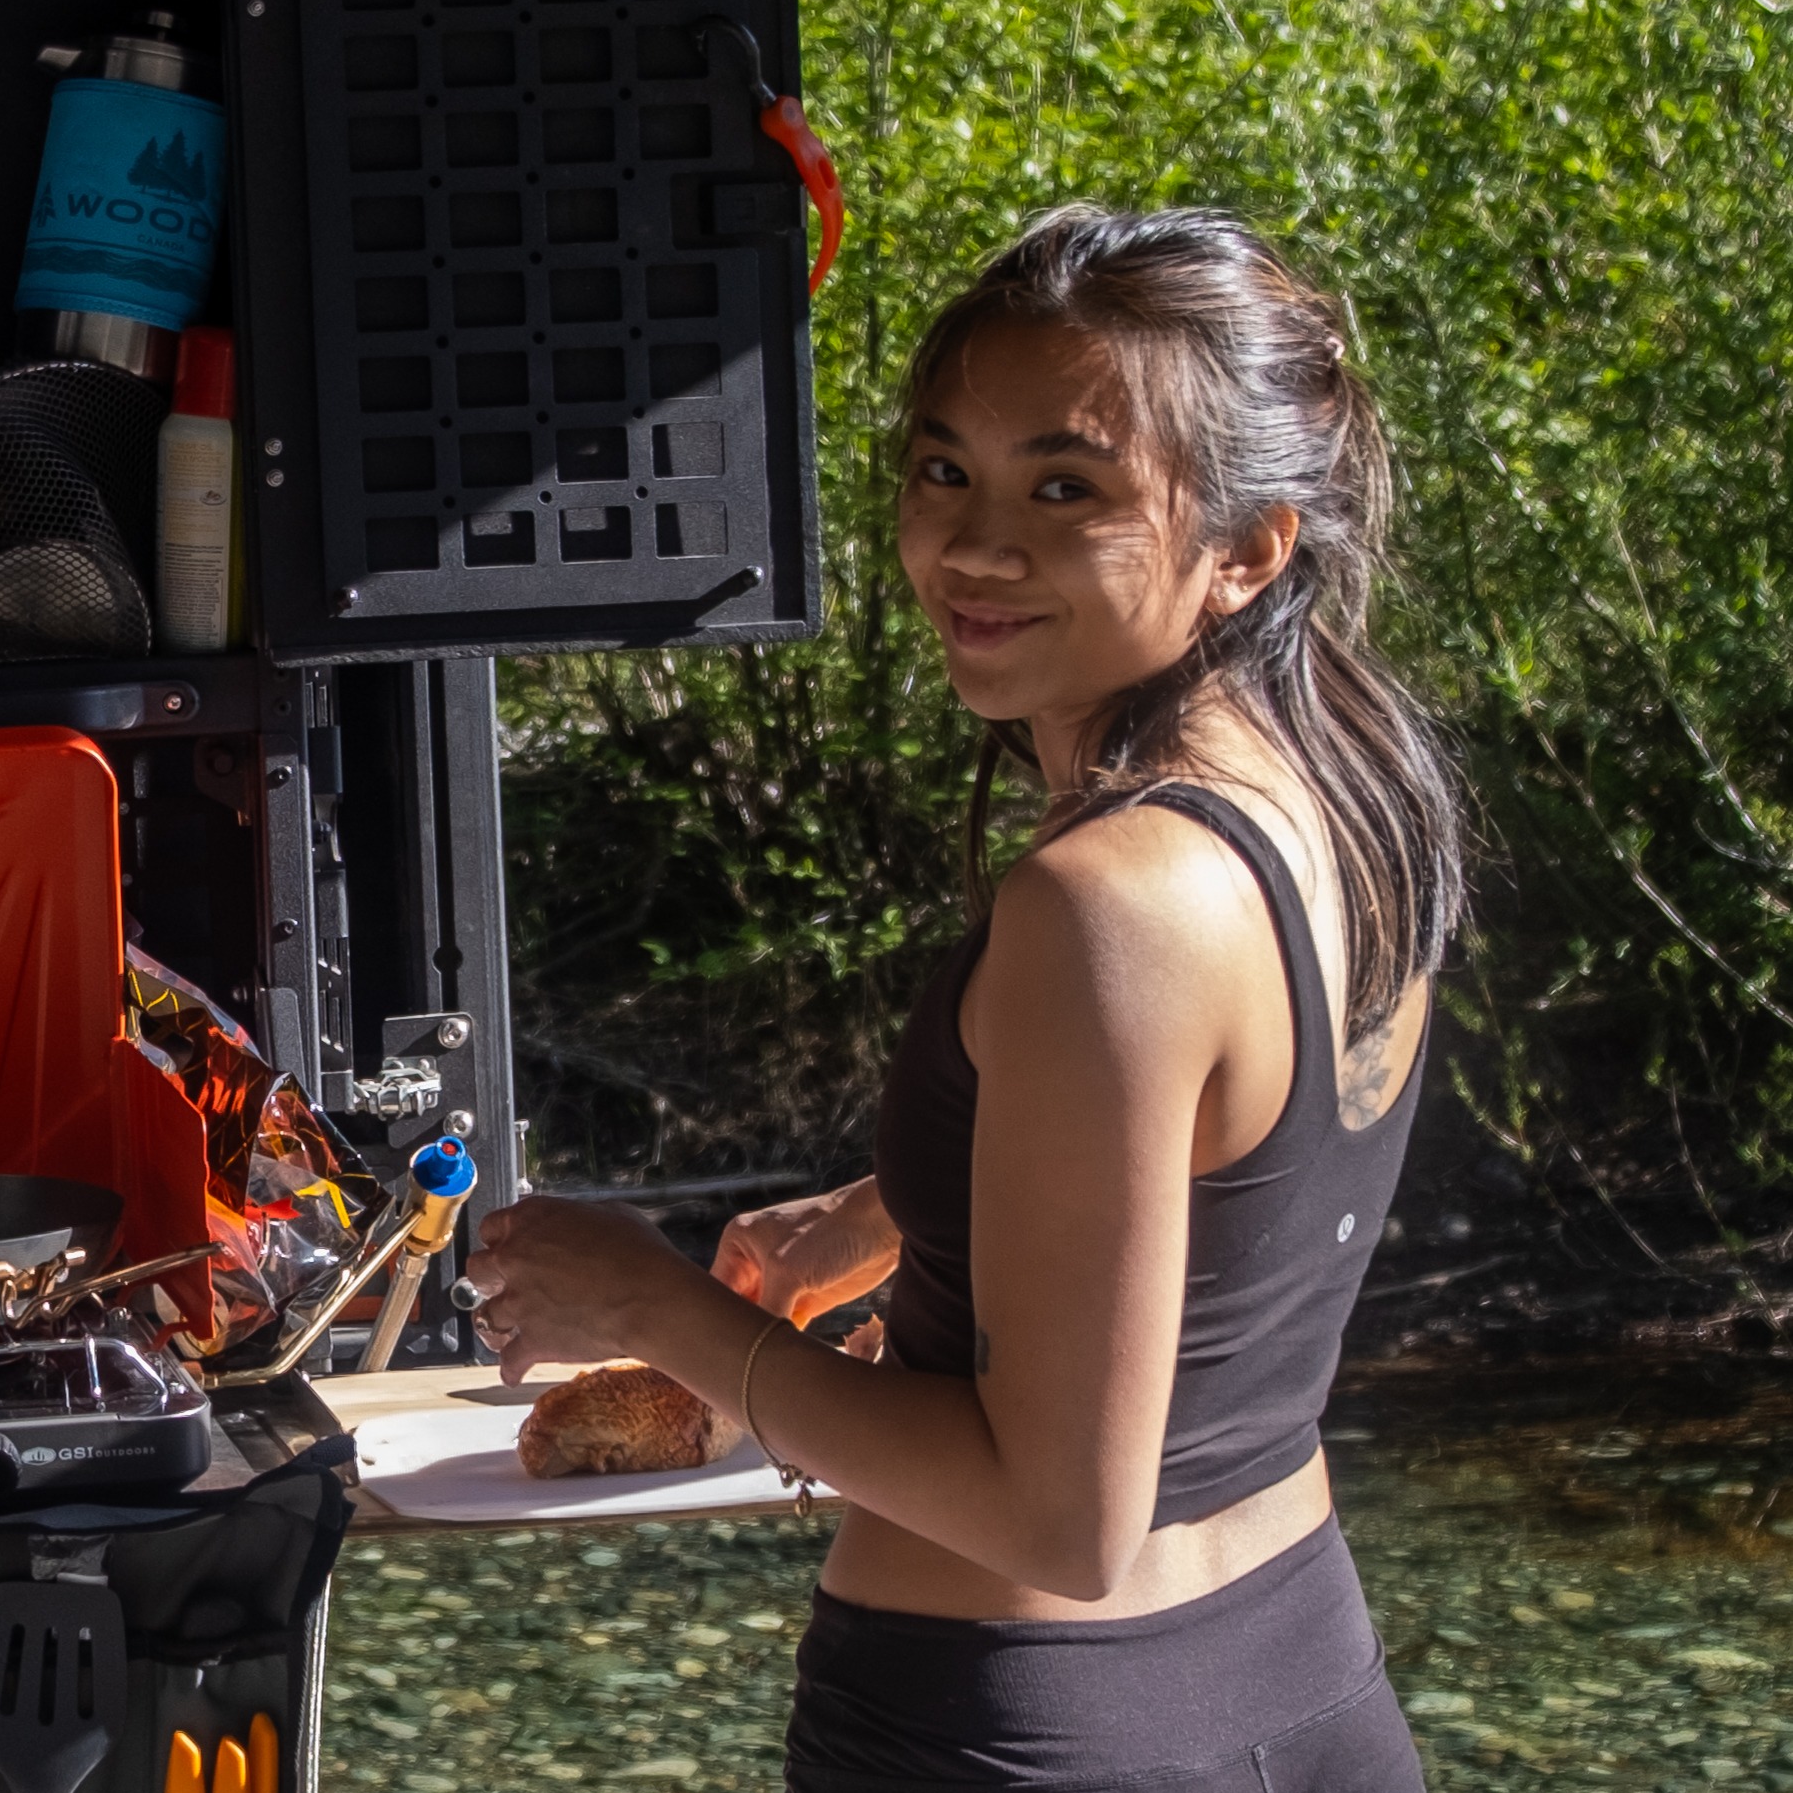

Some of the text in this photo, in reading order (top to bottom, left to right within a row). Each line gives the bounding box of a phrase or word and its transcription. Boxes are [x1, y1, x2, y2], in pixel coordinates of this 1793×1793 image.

[137, 234, 185, 254] CANADA
[58, 1446, 156, 1460] GSI OUTDOORS
